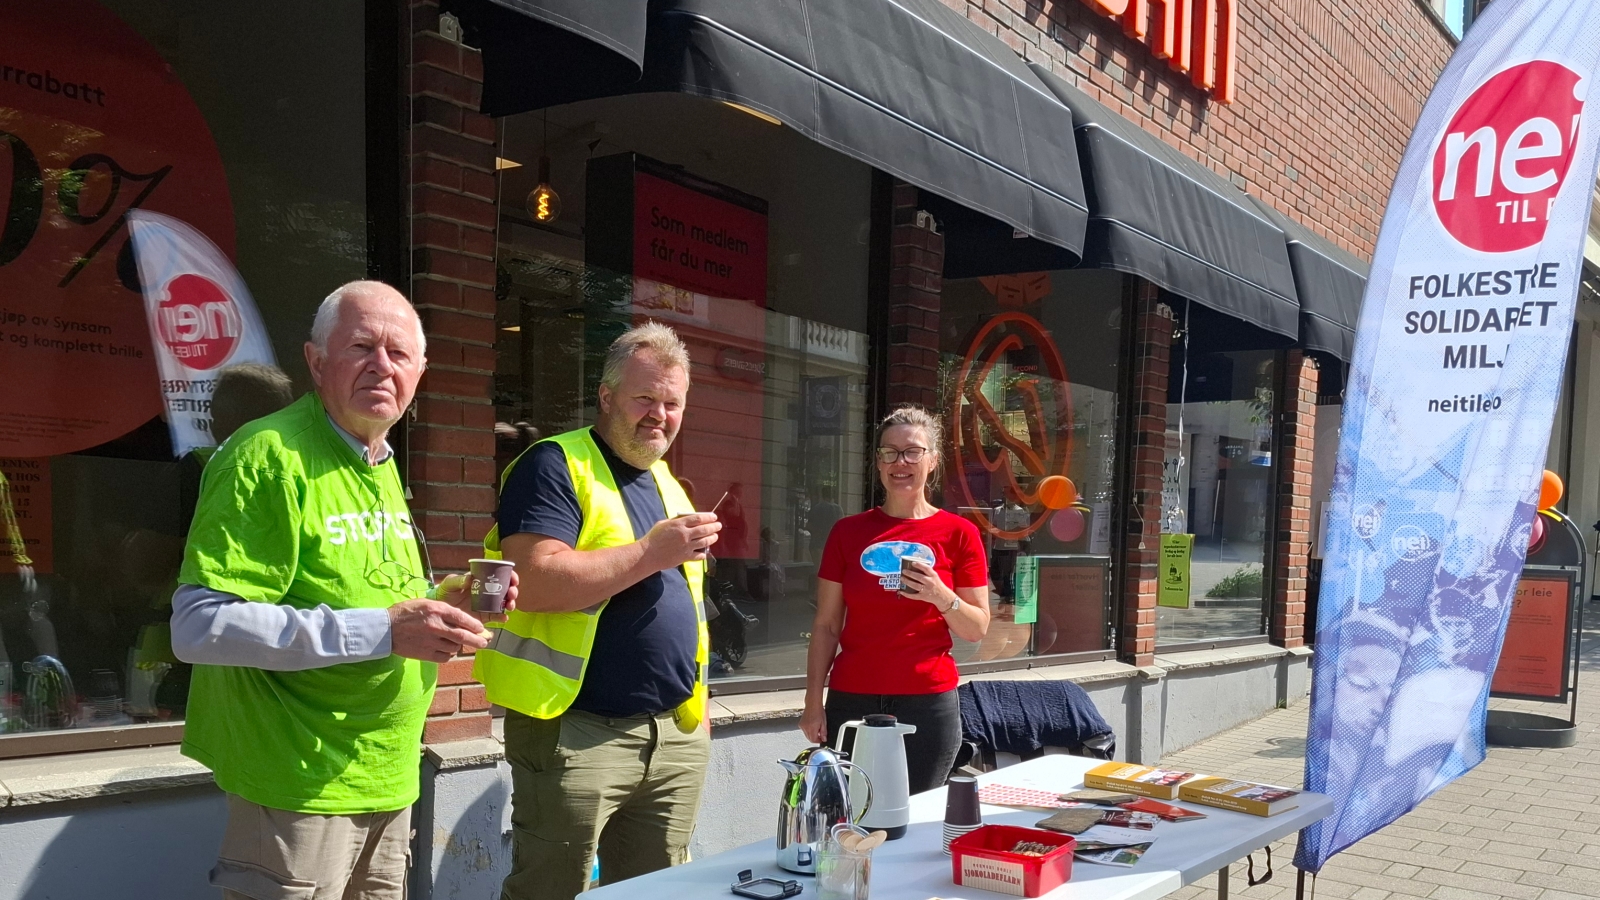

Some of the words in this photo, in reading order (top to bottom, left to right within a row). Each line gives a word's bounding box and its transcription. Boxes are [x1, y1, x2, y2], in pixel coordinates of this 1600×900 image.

[1, 65, 105, 107] rrabatt
[1496, 199, 1536, 224] TIL
[650, 206, 685, 236] Som
[690, 225, 749, 255] medlem
[650, 238, 675, 262] får
[679, 247, 699, 270] du
[704, 258, 733, 279] mer
[0, 308, 27, 326] jøp
[31, 315, 49, 327] av
[53, 316, 112, 335] Synsam
[9, 333, 28, 348] og
[33, 333, 104, 354] komplett
[108, 343, 143, 359] brille
[16, 472, 40, 482] HOS
[1532, 587, 1553, 598] leie
[964, 868, 1022, 886] SJOKOLADEFLARN
